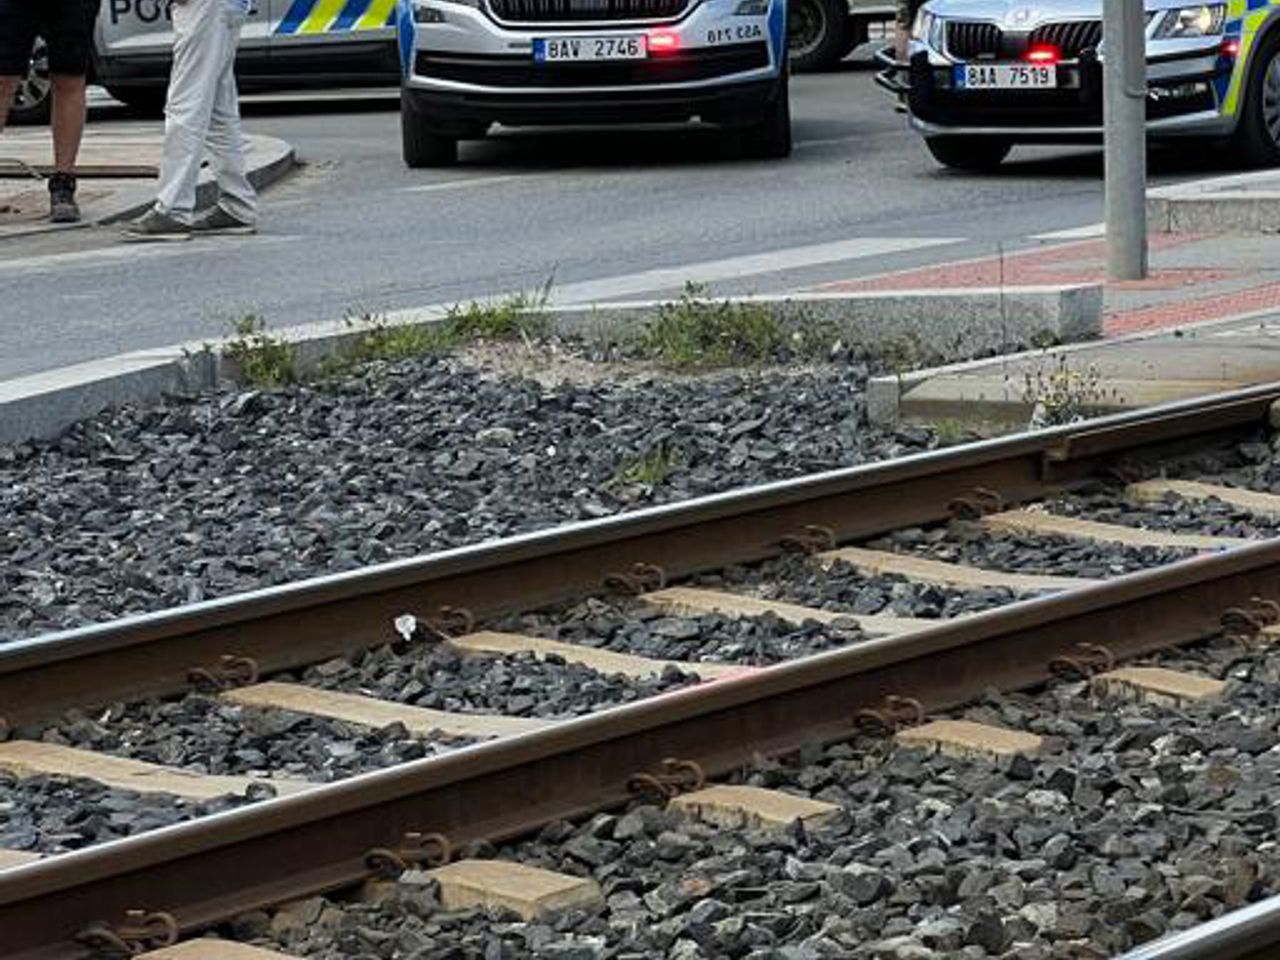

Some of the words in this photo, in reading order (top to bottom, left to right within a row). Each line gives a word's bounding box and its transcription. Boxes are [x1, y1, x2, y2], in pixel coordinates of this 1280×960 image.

[548, 40, 581, 59] 8AV
[595, 39, 639, 56] 2746
[968, 66, 996, 86] 8AA
[1009, 66, 1049, 85] 7519
